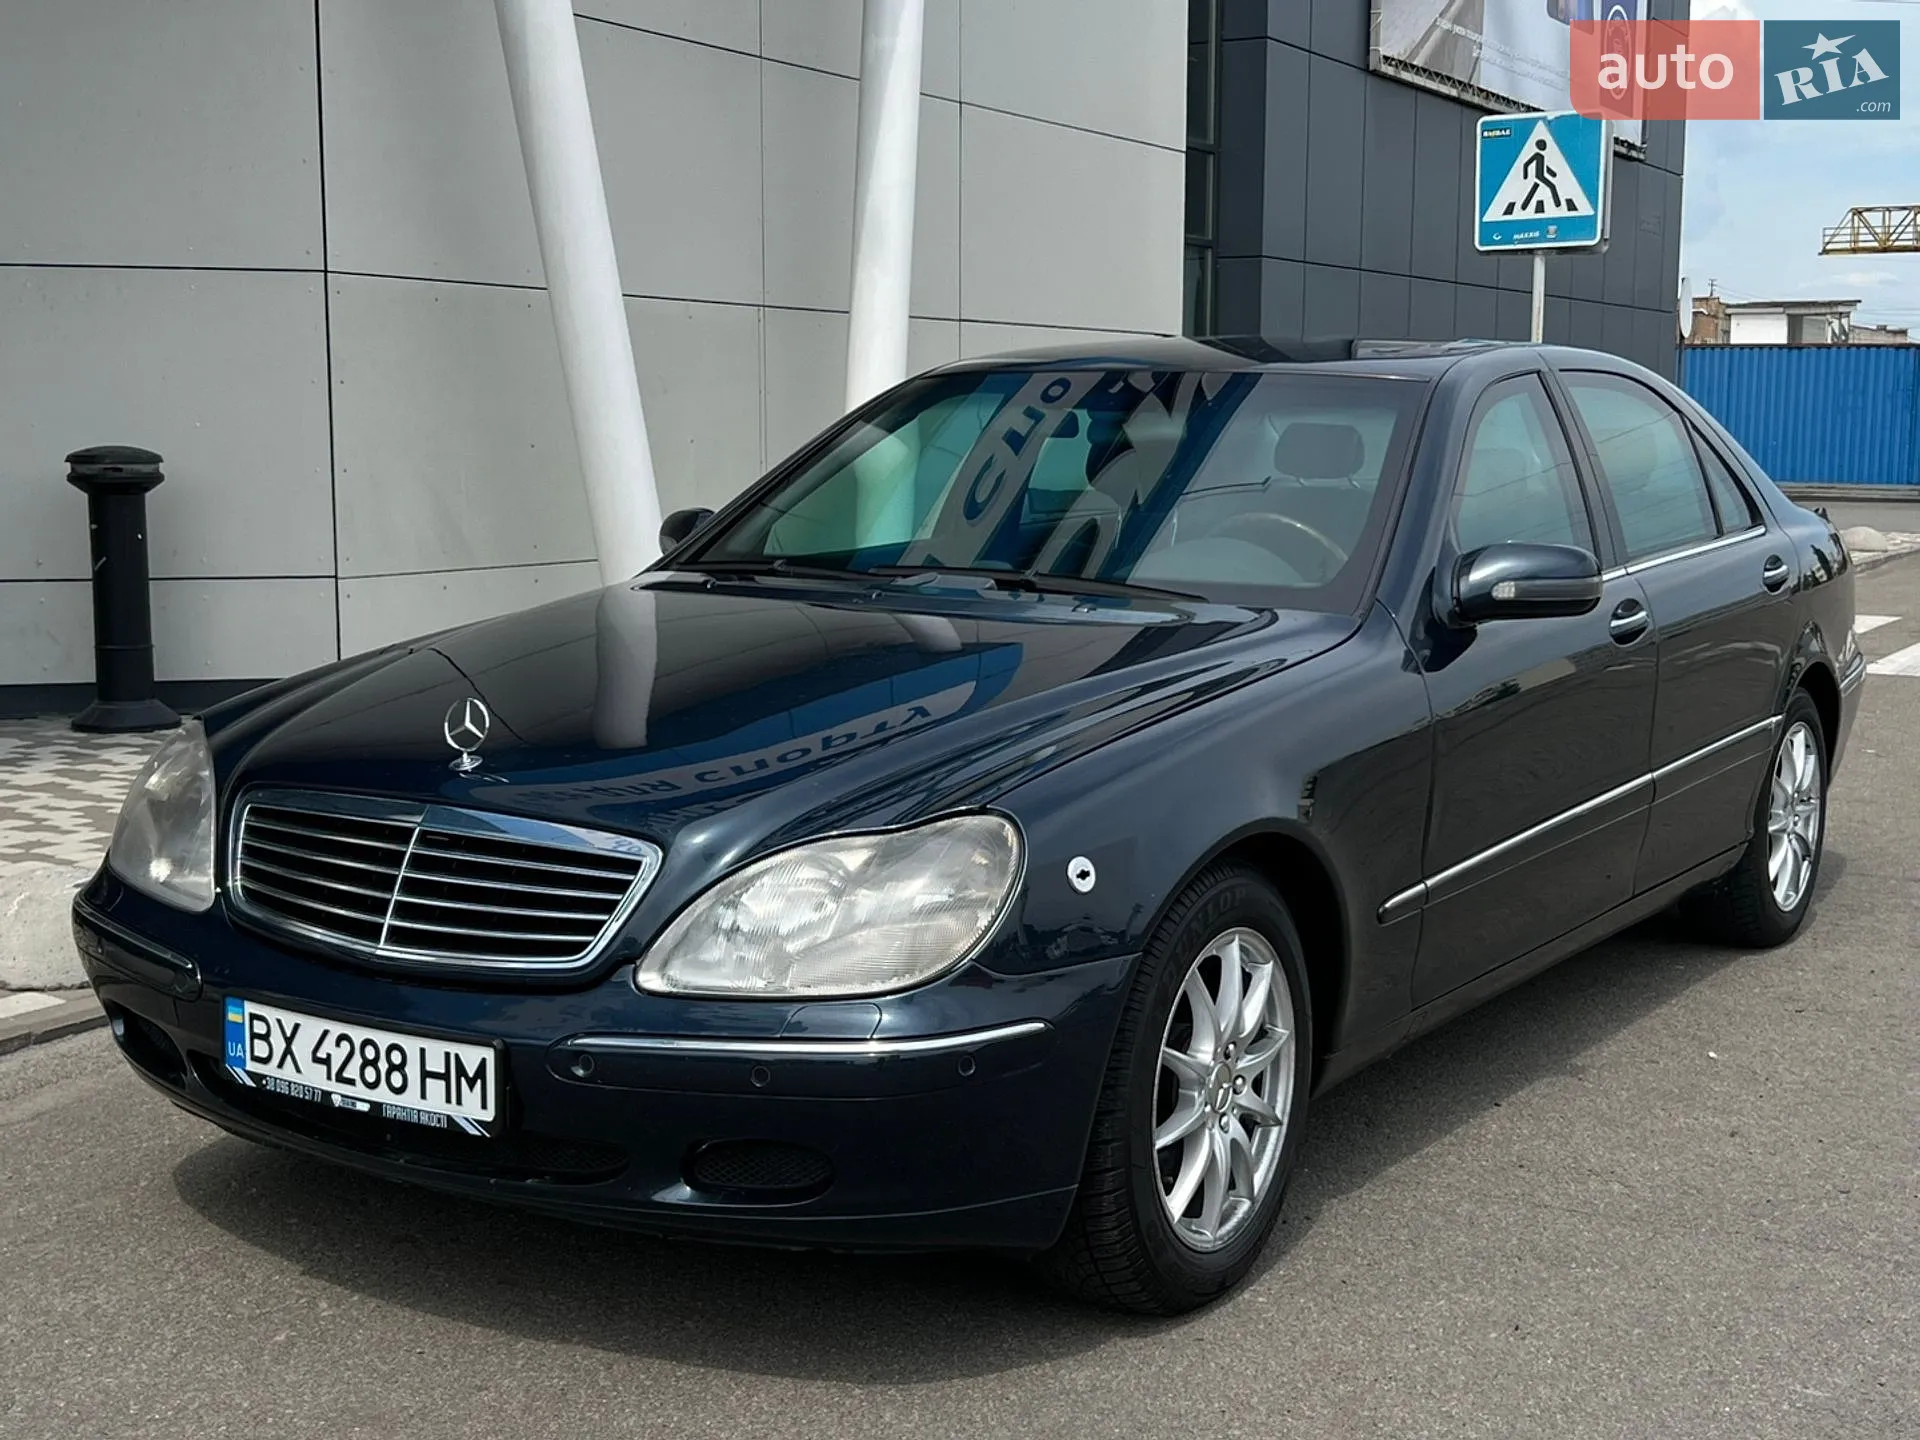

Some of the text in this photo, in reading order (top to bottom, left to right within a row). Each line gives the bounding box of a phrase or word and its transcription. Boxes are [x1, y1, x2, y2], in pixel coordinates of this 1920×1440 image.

[228, 1041, 244, 1058] UA
[249, 1012, 488, 1110] BX 4288 HM
